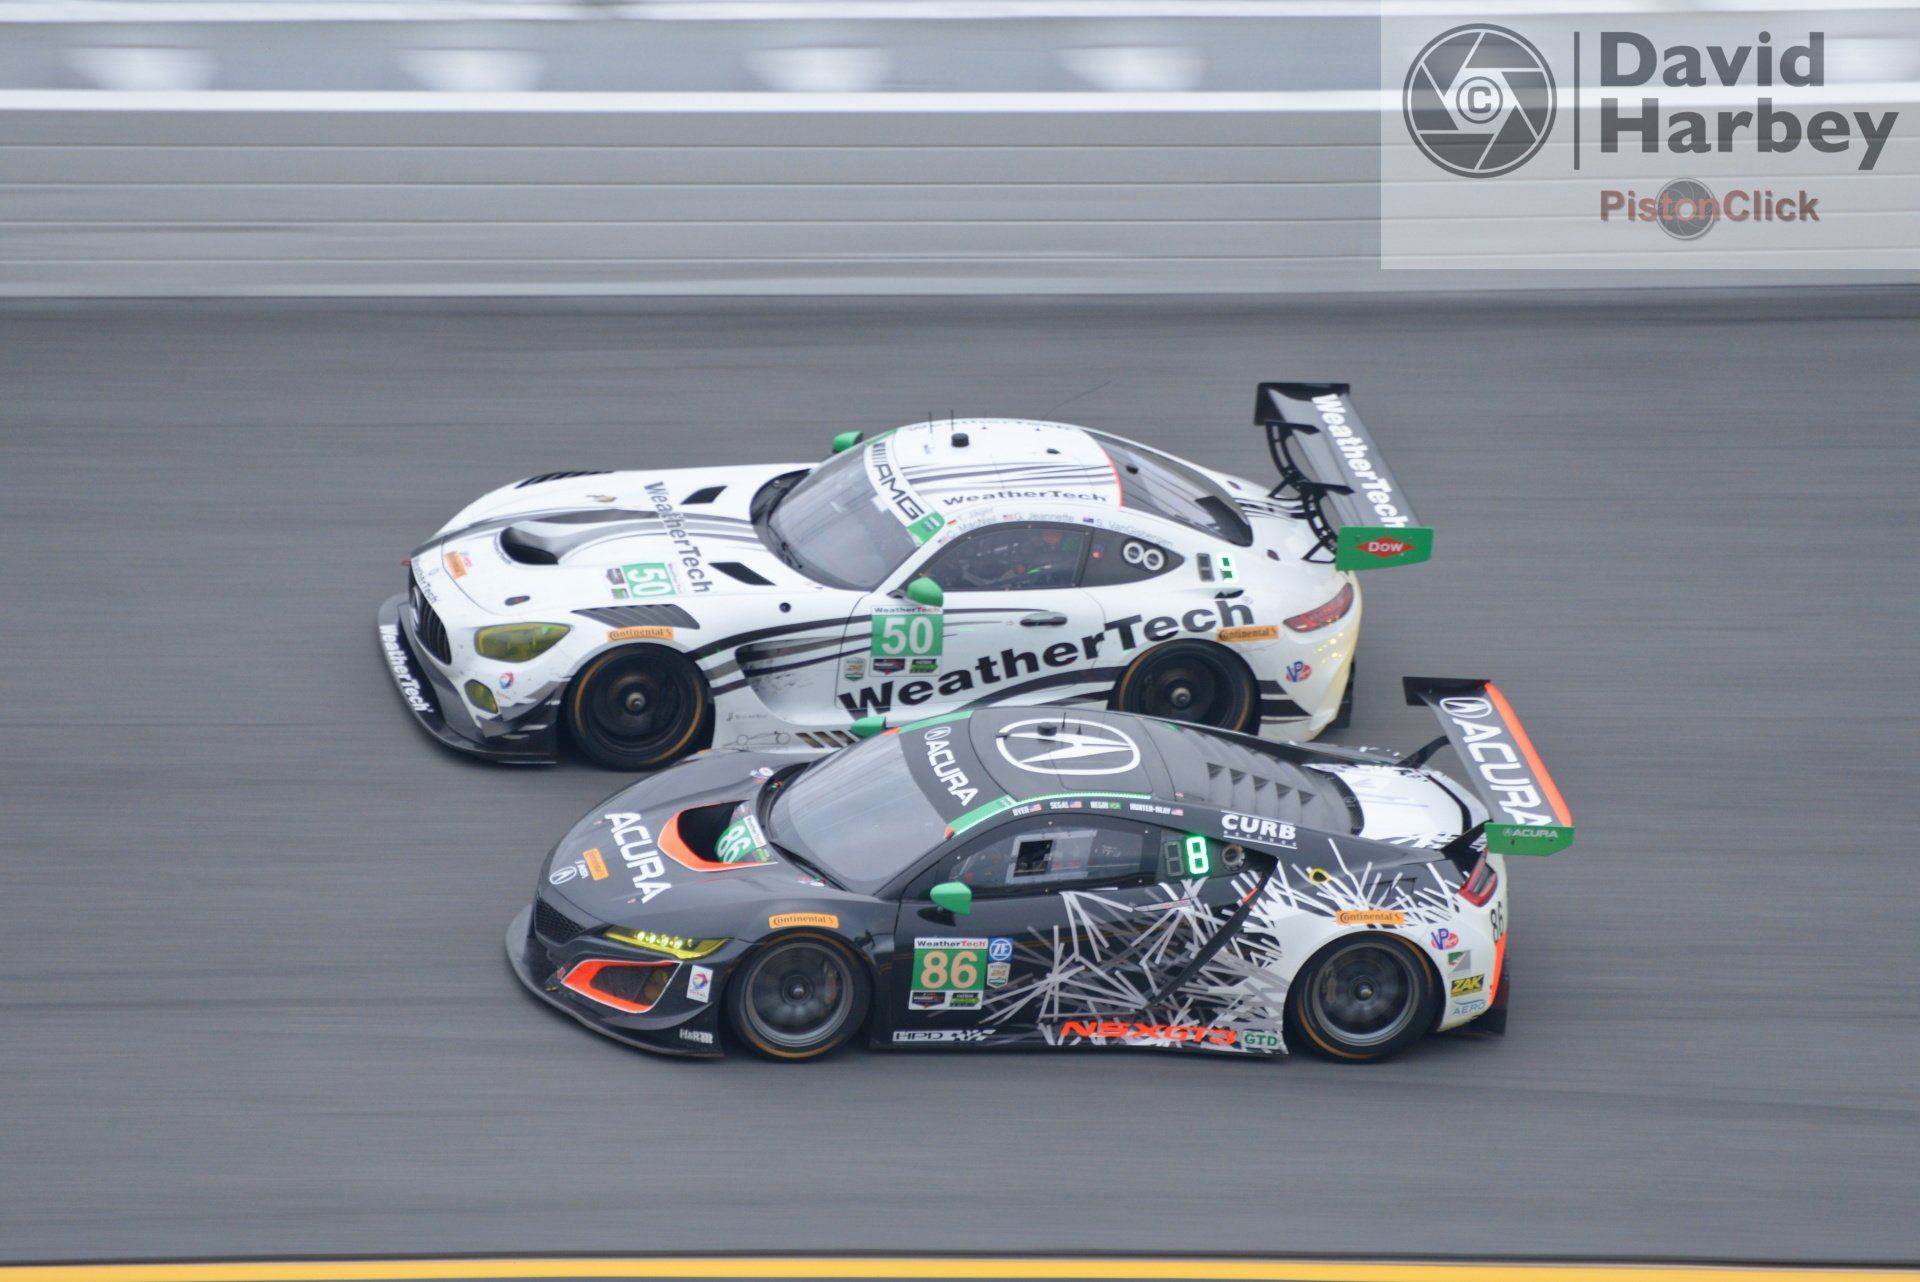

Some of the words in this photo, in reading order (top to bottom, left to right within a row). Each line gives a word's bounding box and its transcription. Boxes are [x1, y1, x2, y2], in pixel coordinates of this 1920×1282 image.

[1312, 393, 1409, 528] WeatherTech
[873, 463, 925, 520] AMG
[942, 490, 1107, 506] WeatherTech
[644, 481, 714, 593] WeatherTech
[627, 567, 672, 596] 50
[882, 616, 934, 655] 50
[379, 624, 431, 712] WeatherTech
[838, 600, 1255, 721] WeatherTech
[926, 741, 979, 807] ACURA
[1452, 718, 1553, 826] ACURA
[717, 825, 752, 864] 86
[1221, 814, 1296, 840] CURB
[1511, 829, 1558, 838] ACURA
[604, 812, 672, 904] ACURA
[773, 915, 826, 926] Continental
[1340, 912, 1393, 924] Continental
[920, 951, 978, 989] 86
[1452, 974, 1484, 993] ZAK
[895, 1032, 943, 1040] HPD
[1244, 1034, 1278, 1047] GTD
